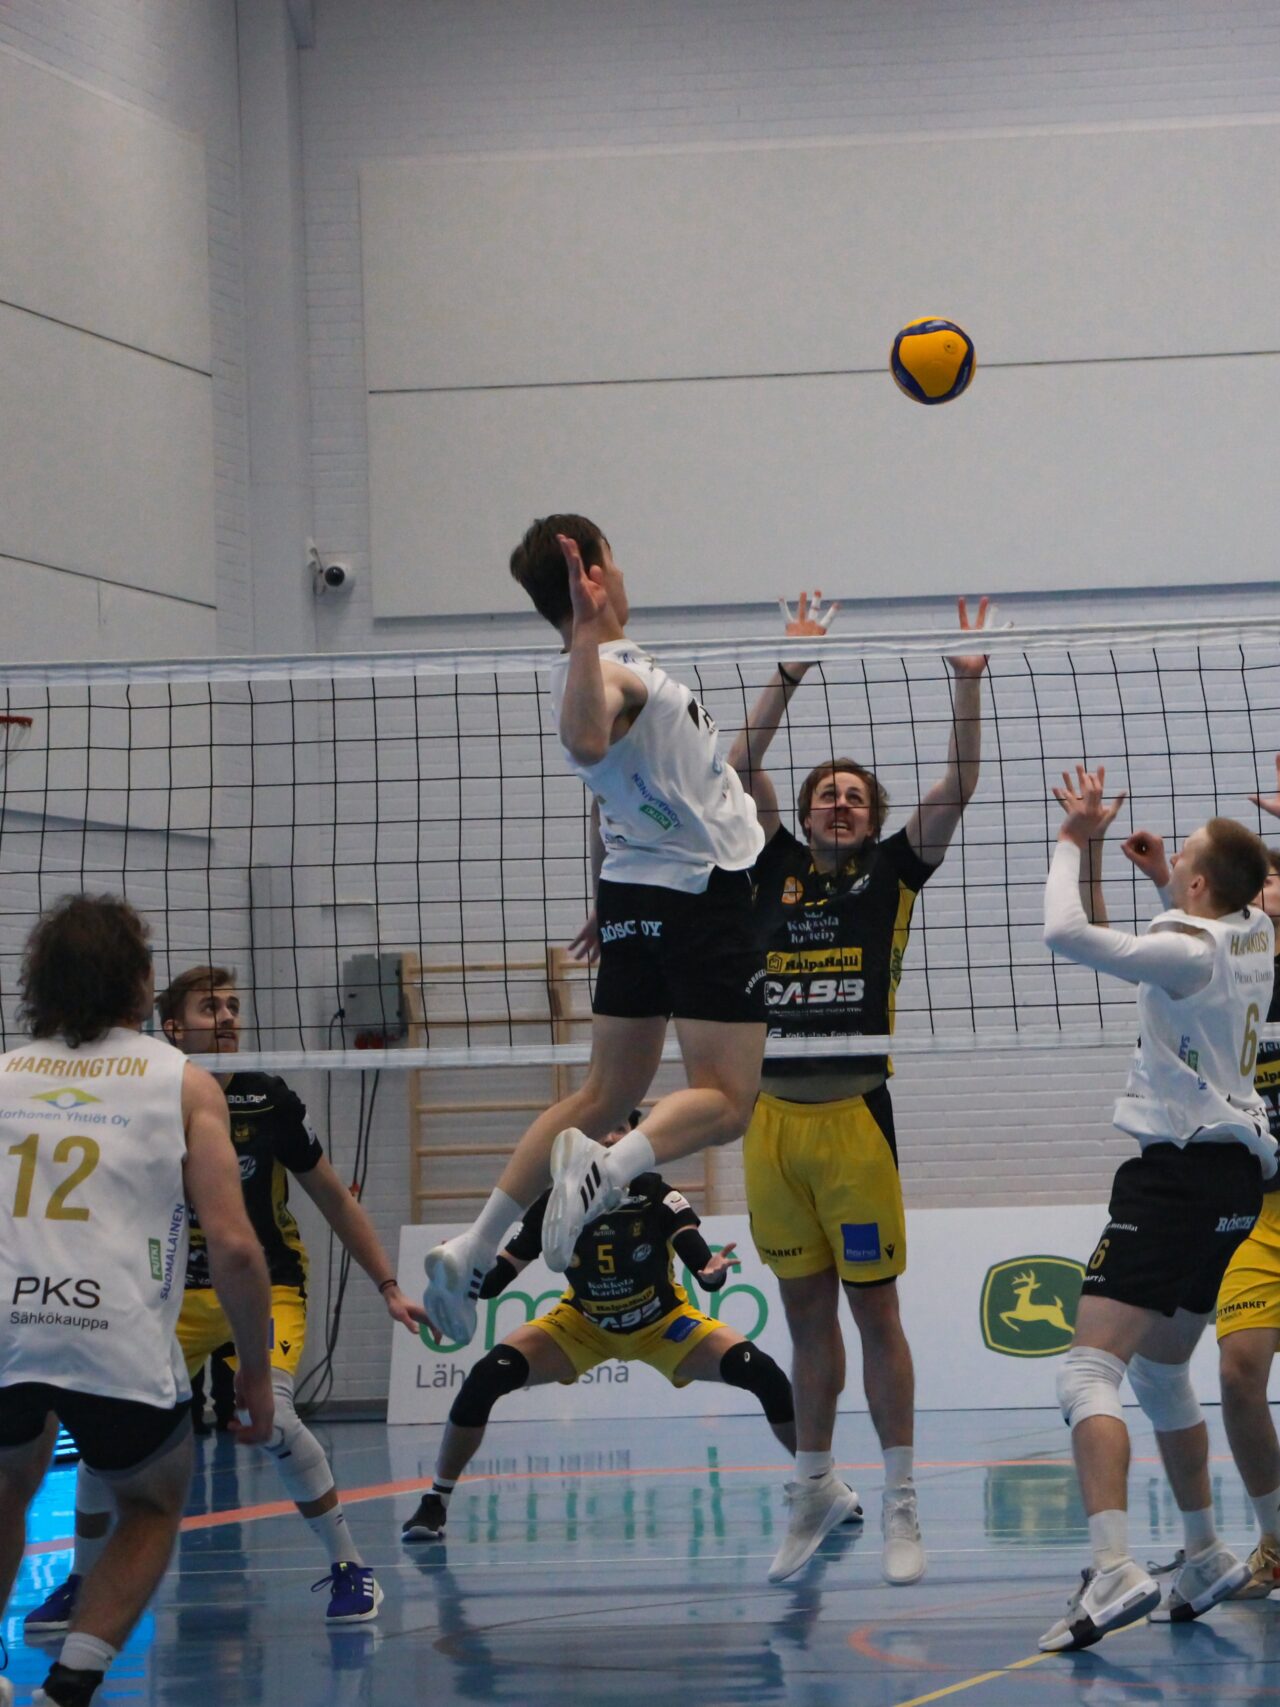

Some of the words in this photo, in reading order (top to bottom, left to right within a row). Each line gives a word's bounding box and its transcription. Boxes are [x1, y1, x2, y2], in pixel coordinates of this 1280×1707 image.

[765, 979, 865, 1005] CABB
[1239, 1003, 1259, 1077] 6
[5, 1057, 148, 1078] HARRINGTON
[111, 1114, 130, 1128] Oy
[9, 1133, 100, 1222] 12
[160, 1203, 184, 1300] SUOMALAINEN
[597, 1244, 616, 1274] 5
[1090, 1239, 1110, 1270] 6
[12, 1276, 101, 1309] PKS
[10, 1311, 109, 1331] Sähkökauppa
[1216, 1301, 1267, 1319] TYMARKET
